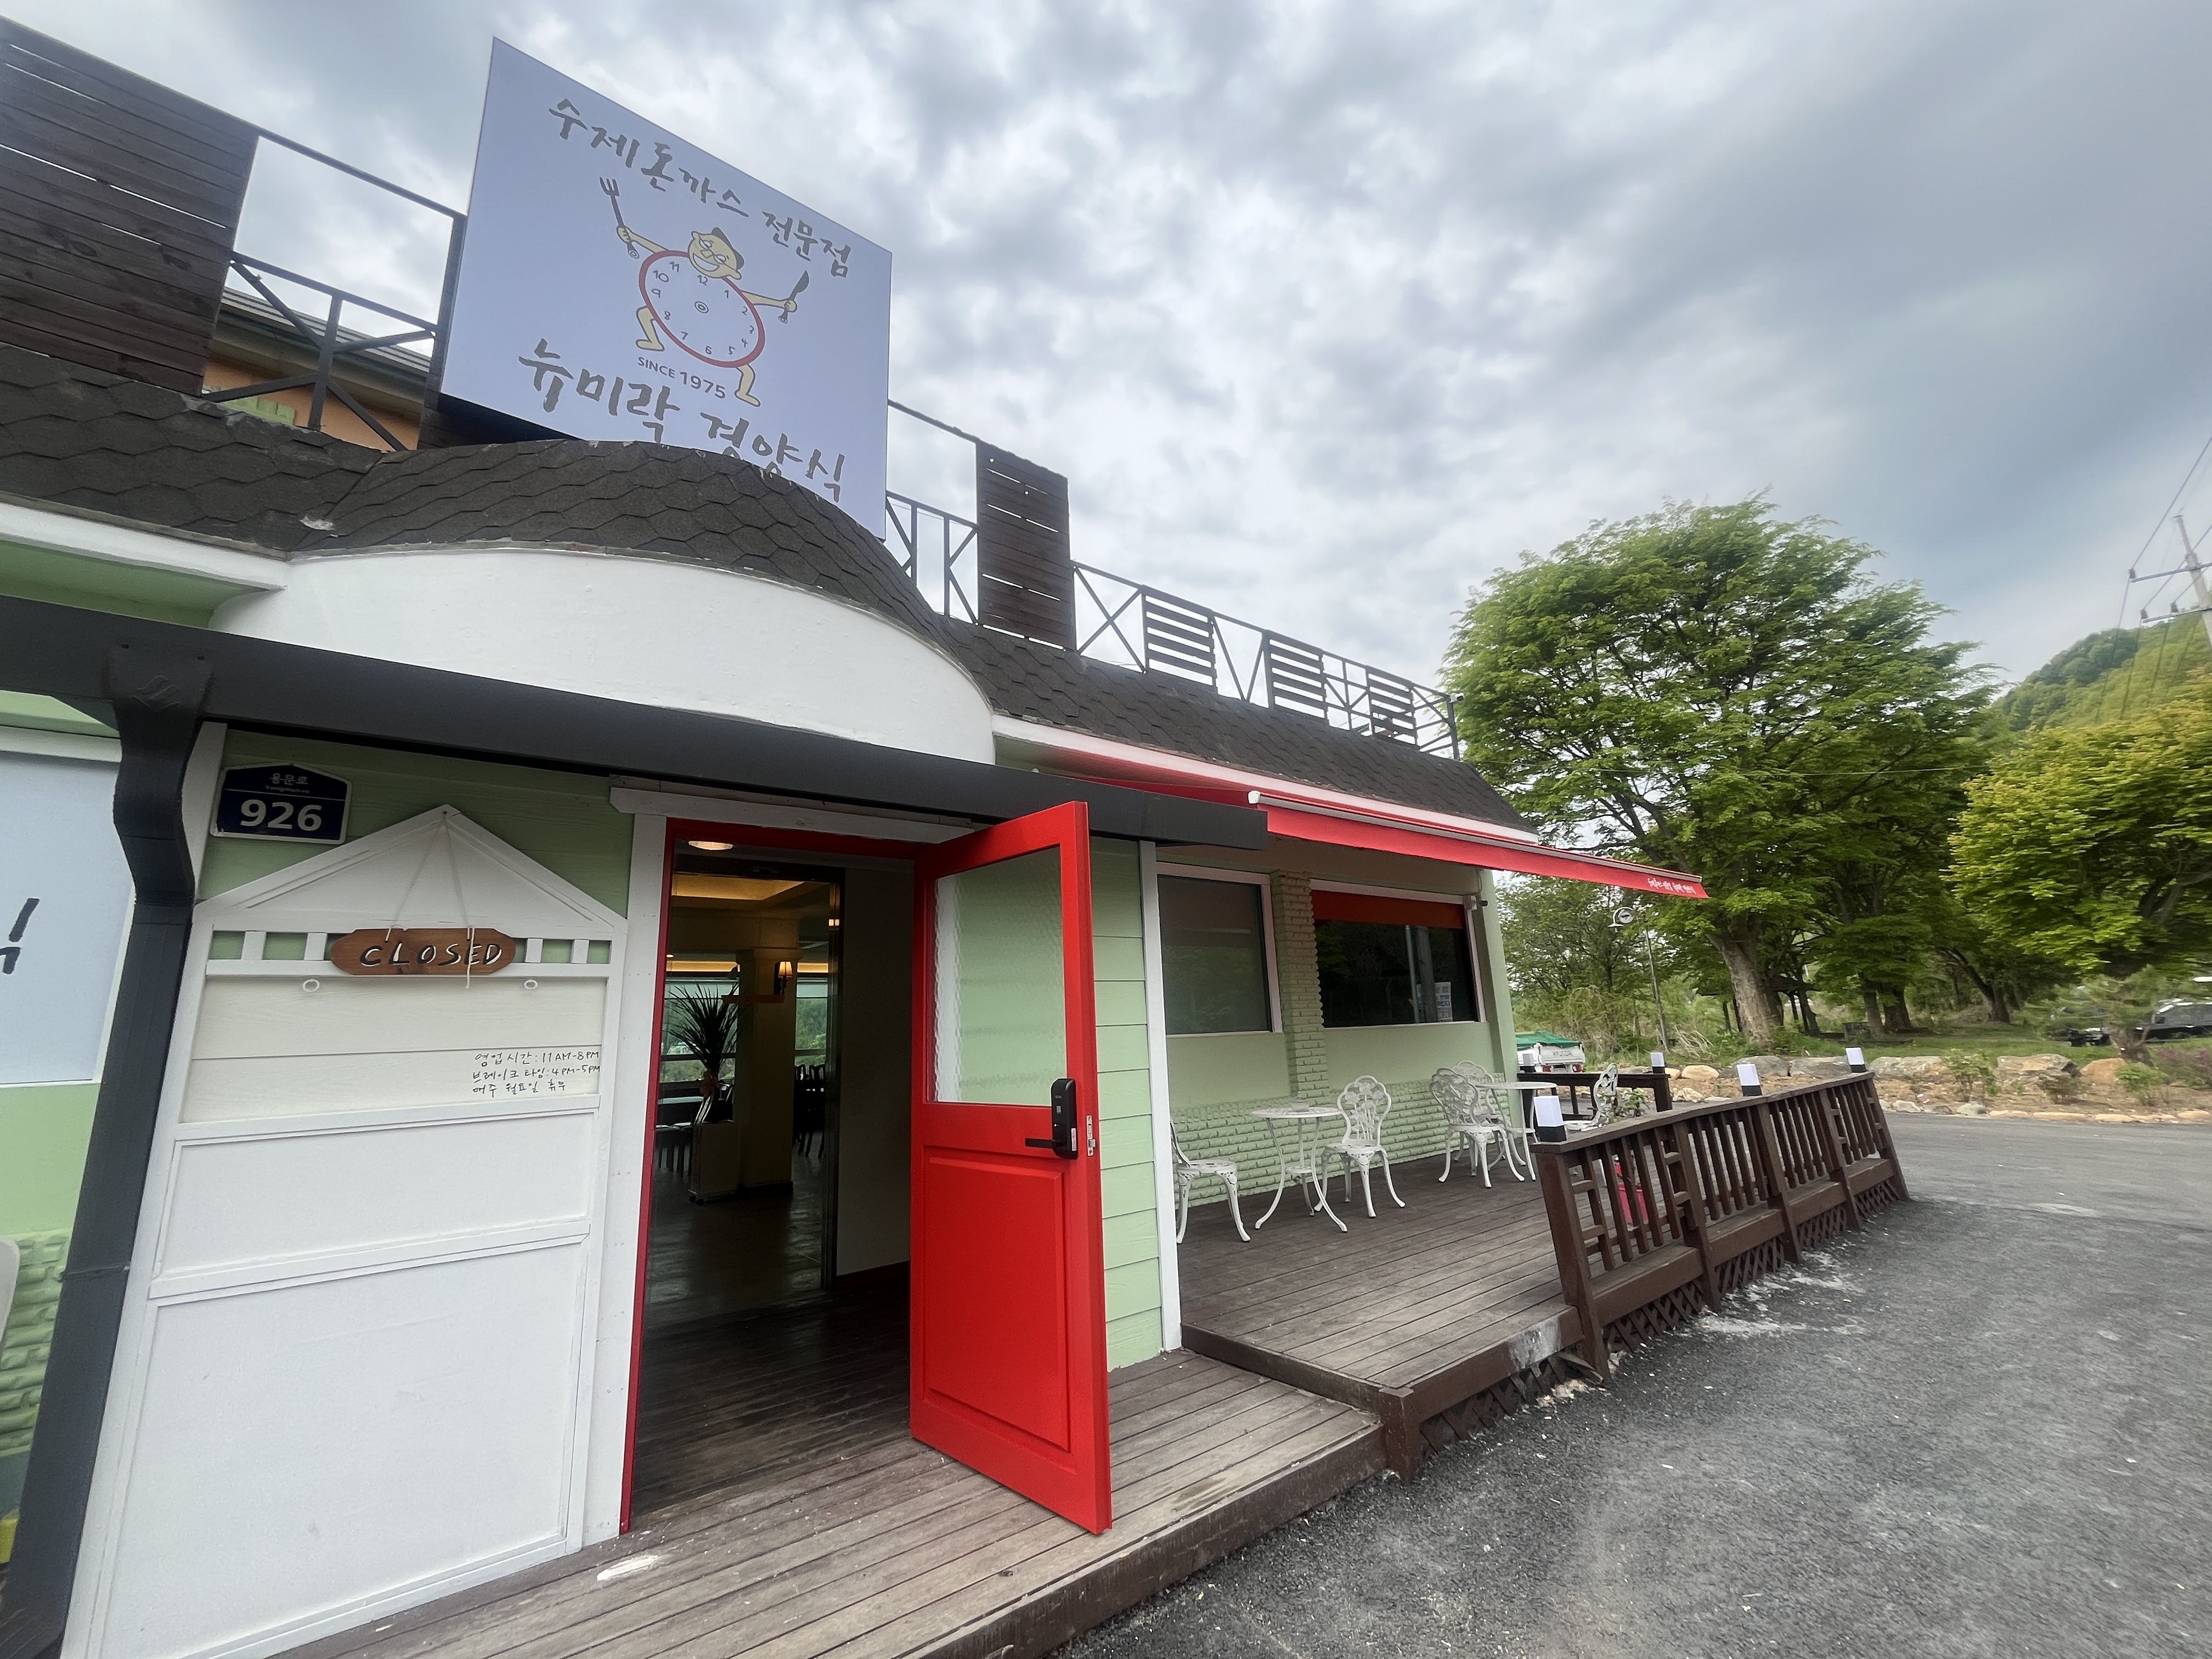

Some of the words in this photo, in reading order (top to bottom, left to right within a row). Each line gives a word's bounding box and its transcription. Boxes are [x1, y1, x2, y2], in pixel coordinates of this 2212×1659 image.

[762, 211, 851, 278] 전문점
[669, 261, 680, 273] 11
[653, 270, 669, 283] 10
[697, 275, 708, 286] 12
[651, 288, 661, 298] 9
[724, 290, 729, 298] 1
[664, 311, 671, 320] 8
[741, 306, 748, 316] 2
[749, 325, 755, 334] 3
[680, 331, 689, 340] 7
[742, 338, 748, 348] 4
[705, 346, 712, 355] 6
[729, 346, 736, 355] 5
[637, 357, 675, 379] SINCE
[680, 371, 725, 399] 1975
[518, 338, 680, 444] 뉴미락
[700, 412, 845, 503] 경양식
[269, 773, 308, 785] 용문로
[265, 785, 310, 794] Yongmun-ro
[240, 799, 322, 831] 926
[360, 940, 502, 967] CLOSED
[473, 1069, 519, 1084] 브레이크
[506, 1081, 539, 1095] 월요일
[548, 1079, 566, 1091] 휴무
